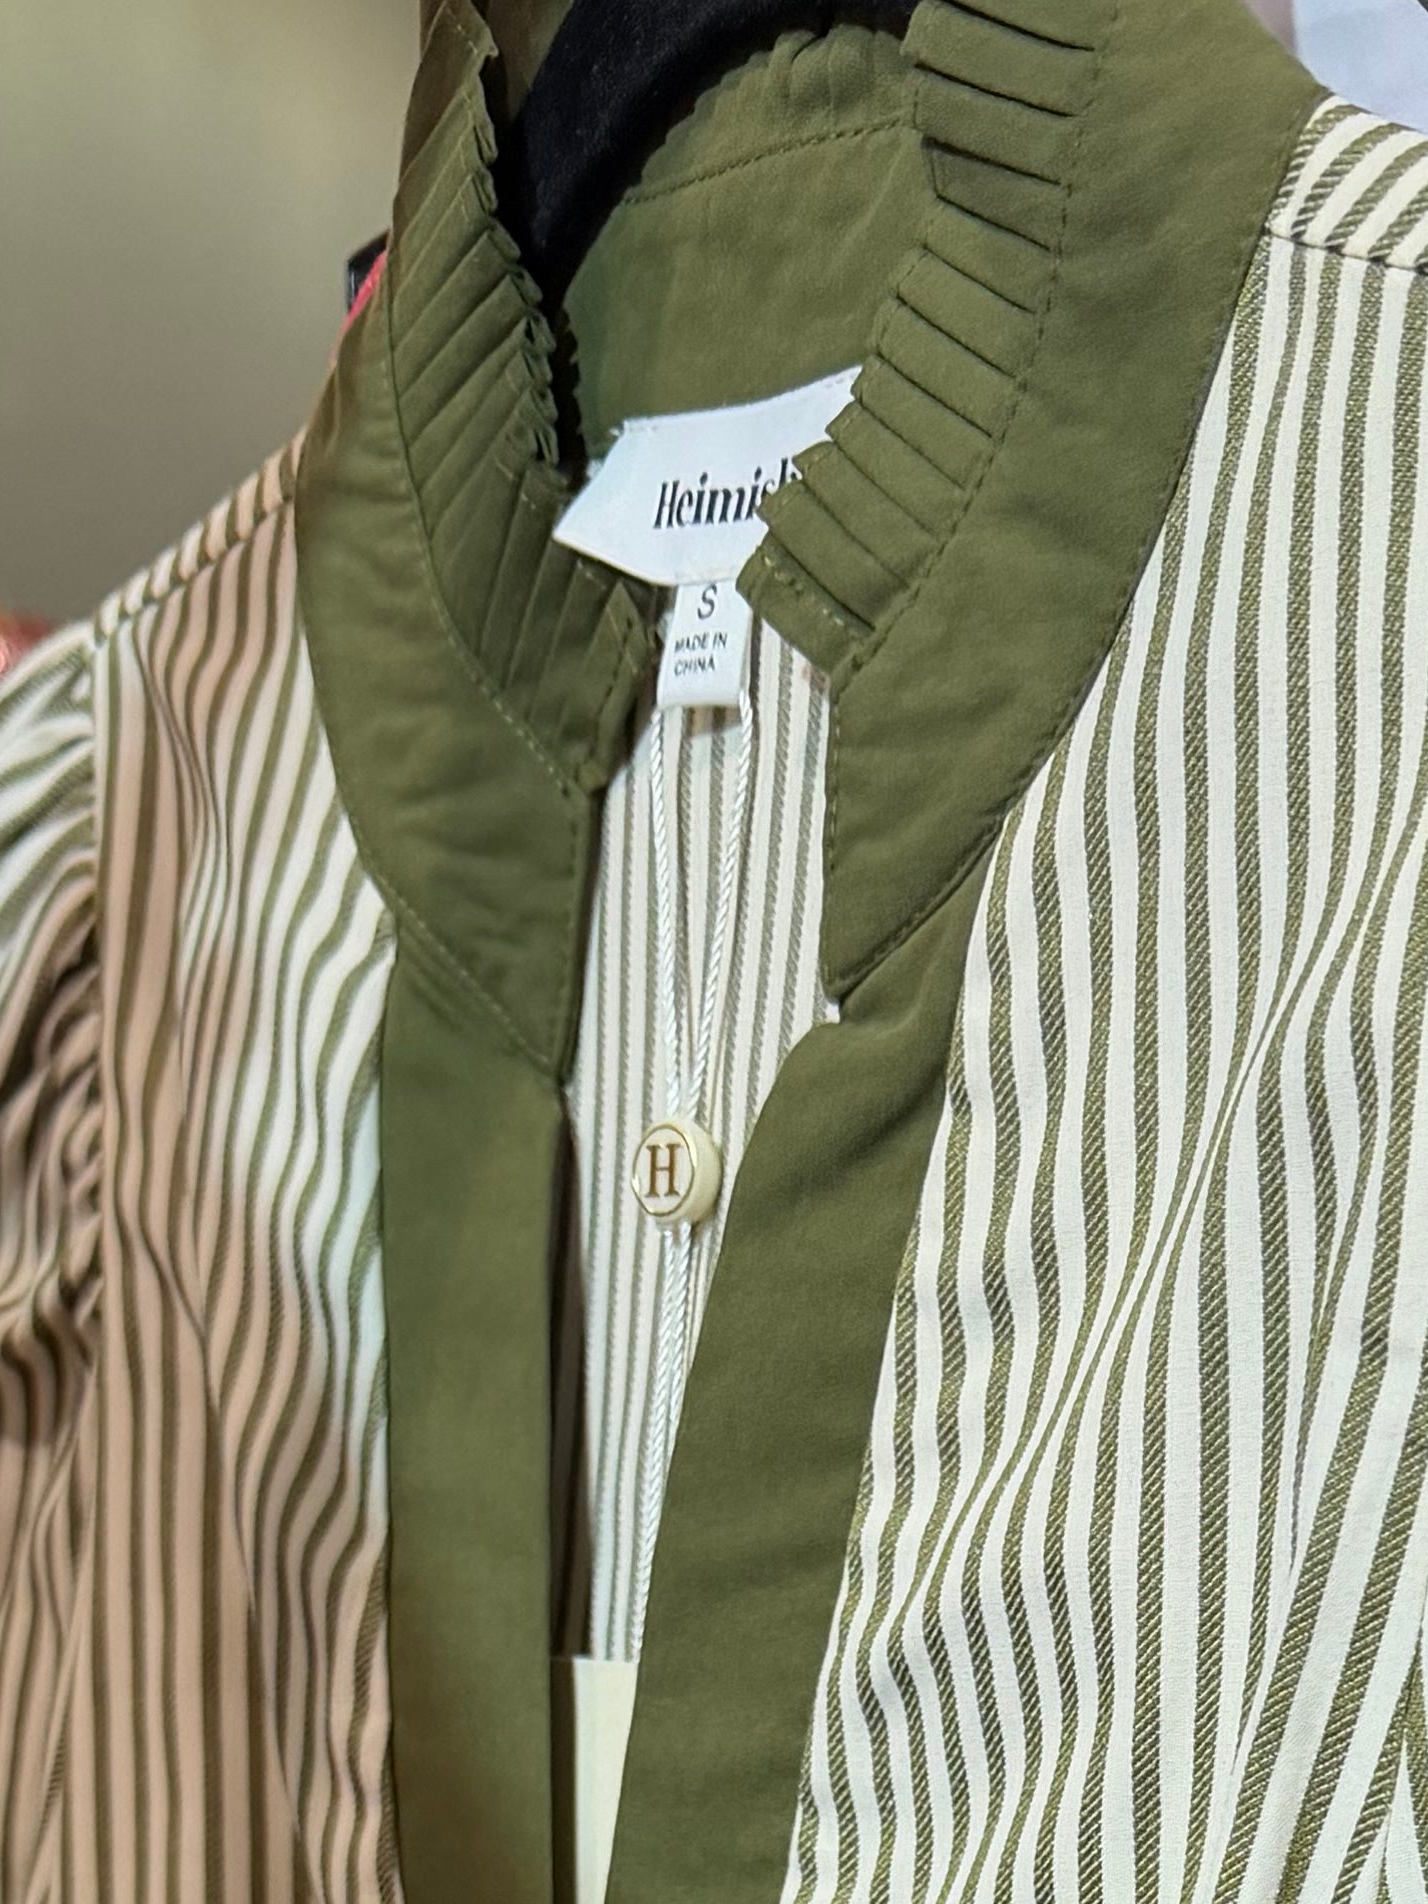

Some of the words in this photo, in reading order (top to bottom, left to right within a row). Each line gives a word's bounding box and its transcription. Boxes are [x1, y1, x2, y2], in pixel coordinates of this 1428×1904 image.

[696, 583, 718, 621] S
[674, 632, 712, 653] MADE
[712, 631, 729, 650] IN
[674, 656, 716, 677] CHINA
[644, 1142, 683, 1199] H
